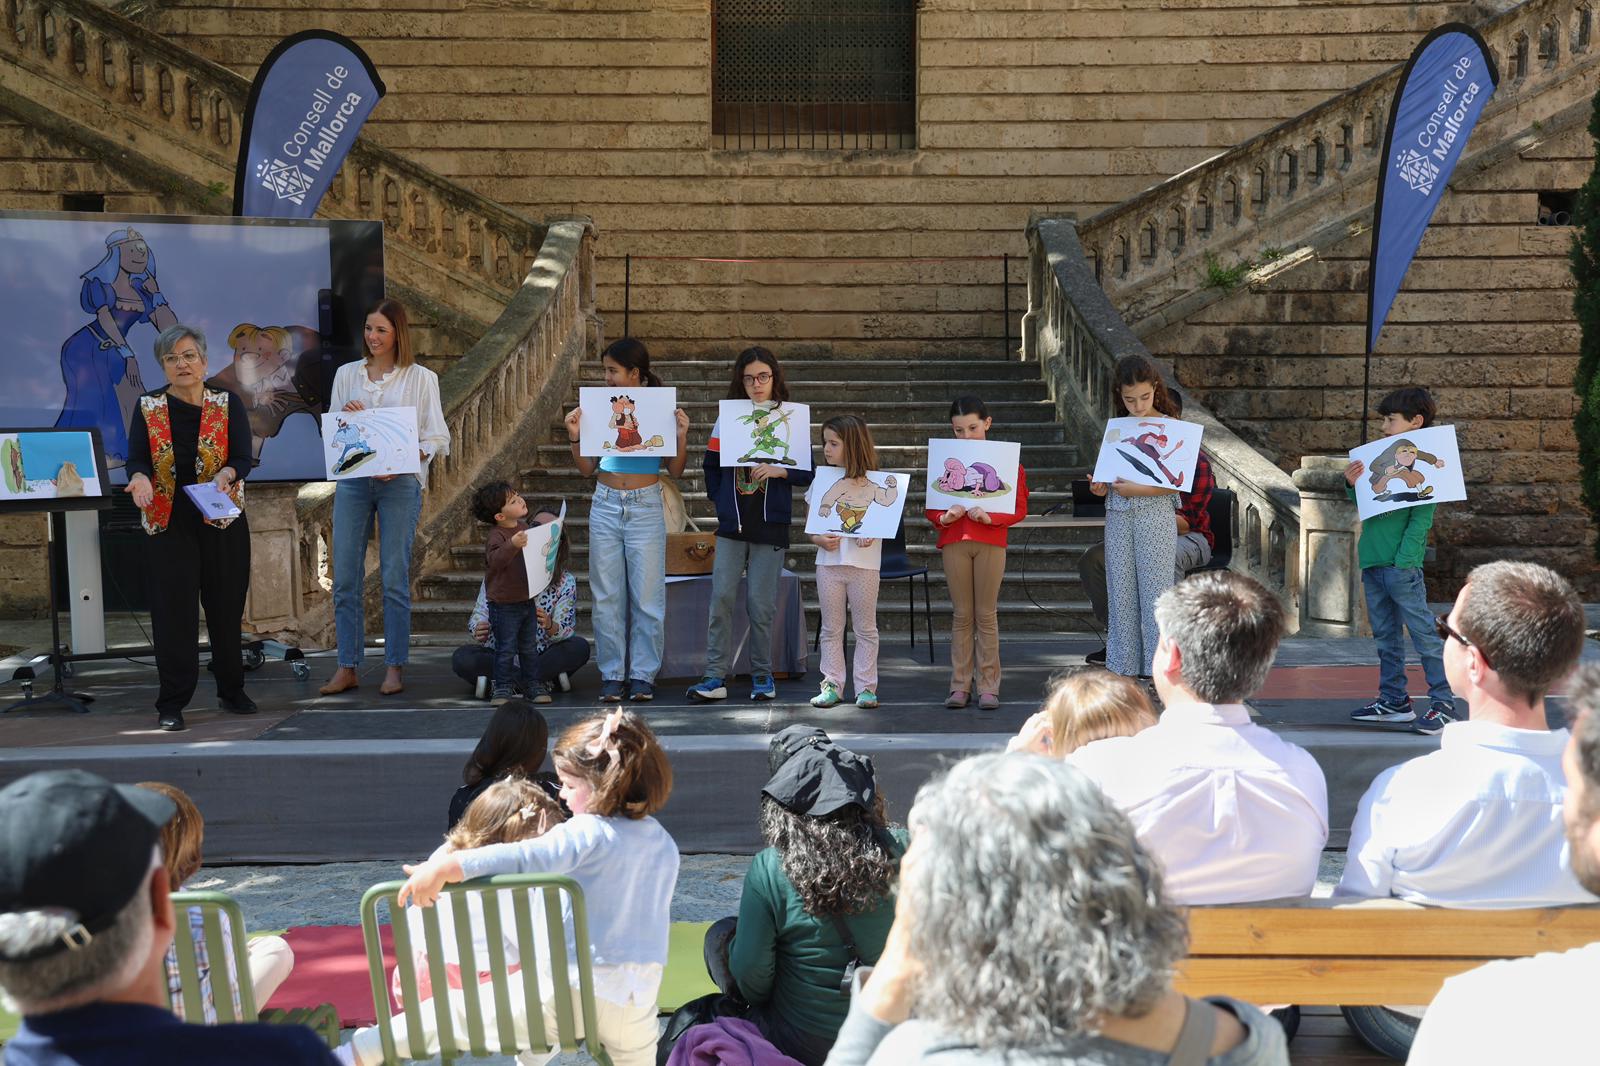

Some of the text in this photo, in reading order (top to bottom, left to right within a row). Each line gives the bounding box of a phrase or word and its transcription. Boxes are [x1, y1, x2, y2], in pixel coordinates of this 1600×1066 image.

[283, 65, 348, 157] Consell de
[303, 92, 362, 171] Mallorca
[1418, 56, 1471, 147] Consell de
[1432, 82, 1480, 161] Mallorca
